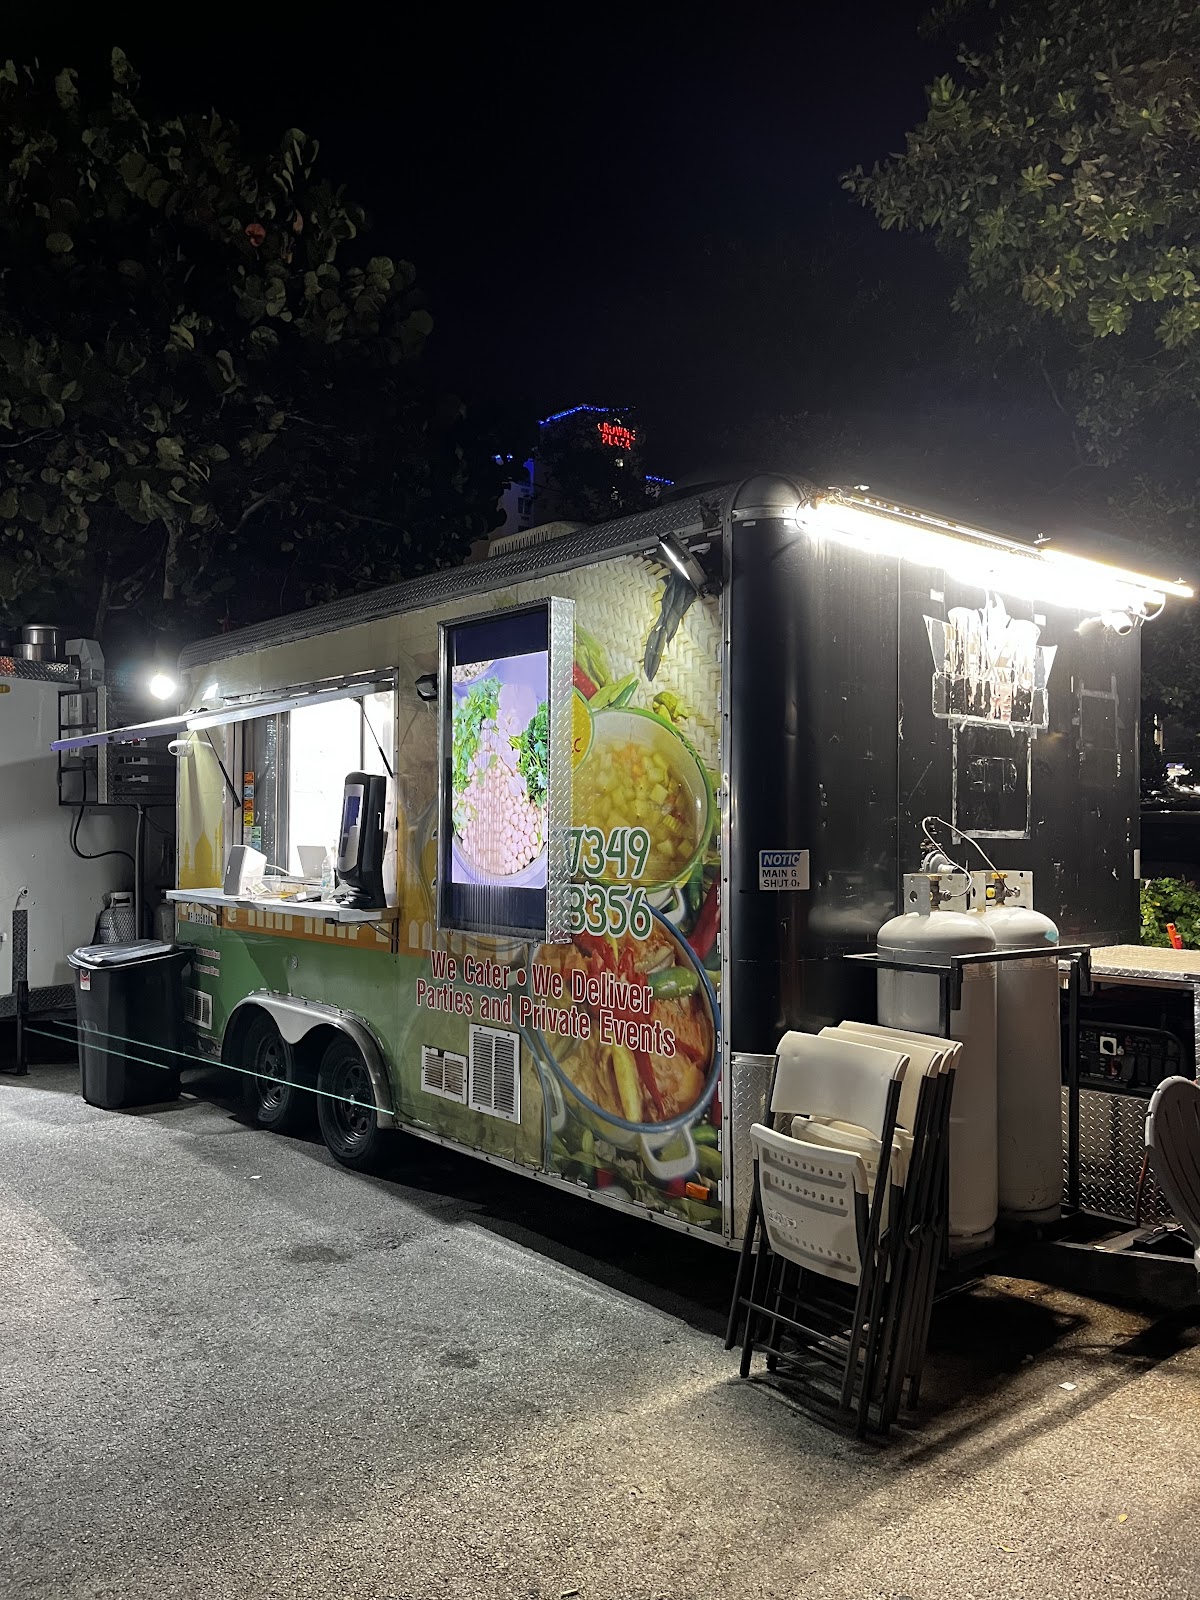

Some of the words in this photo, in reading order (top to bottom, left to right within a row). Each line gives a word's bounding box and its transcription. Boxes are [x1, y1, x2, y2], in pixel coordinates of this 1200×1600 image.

[762, 869, 787, 878] MAIN
[763, 879, 788, 887] SHUT
[431, 950, 457, 982] We
[463, 954, 511, 990] Cater
[532, 963, 563, 999] We
[572, 969, 654, 1014] Deliver
[416, 978, 474, 1016] Parties
[480, 993, 513, 1024] and
[519, 995, 591, 1040] Private
[599, 1009, 676, 1058] Events
